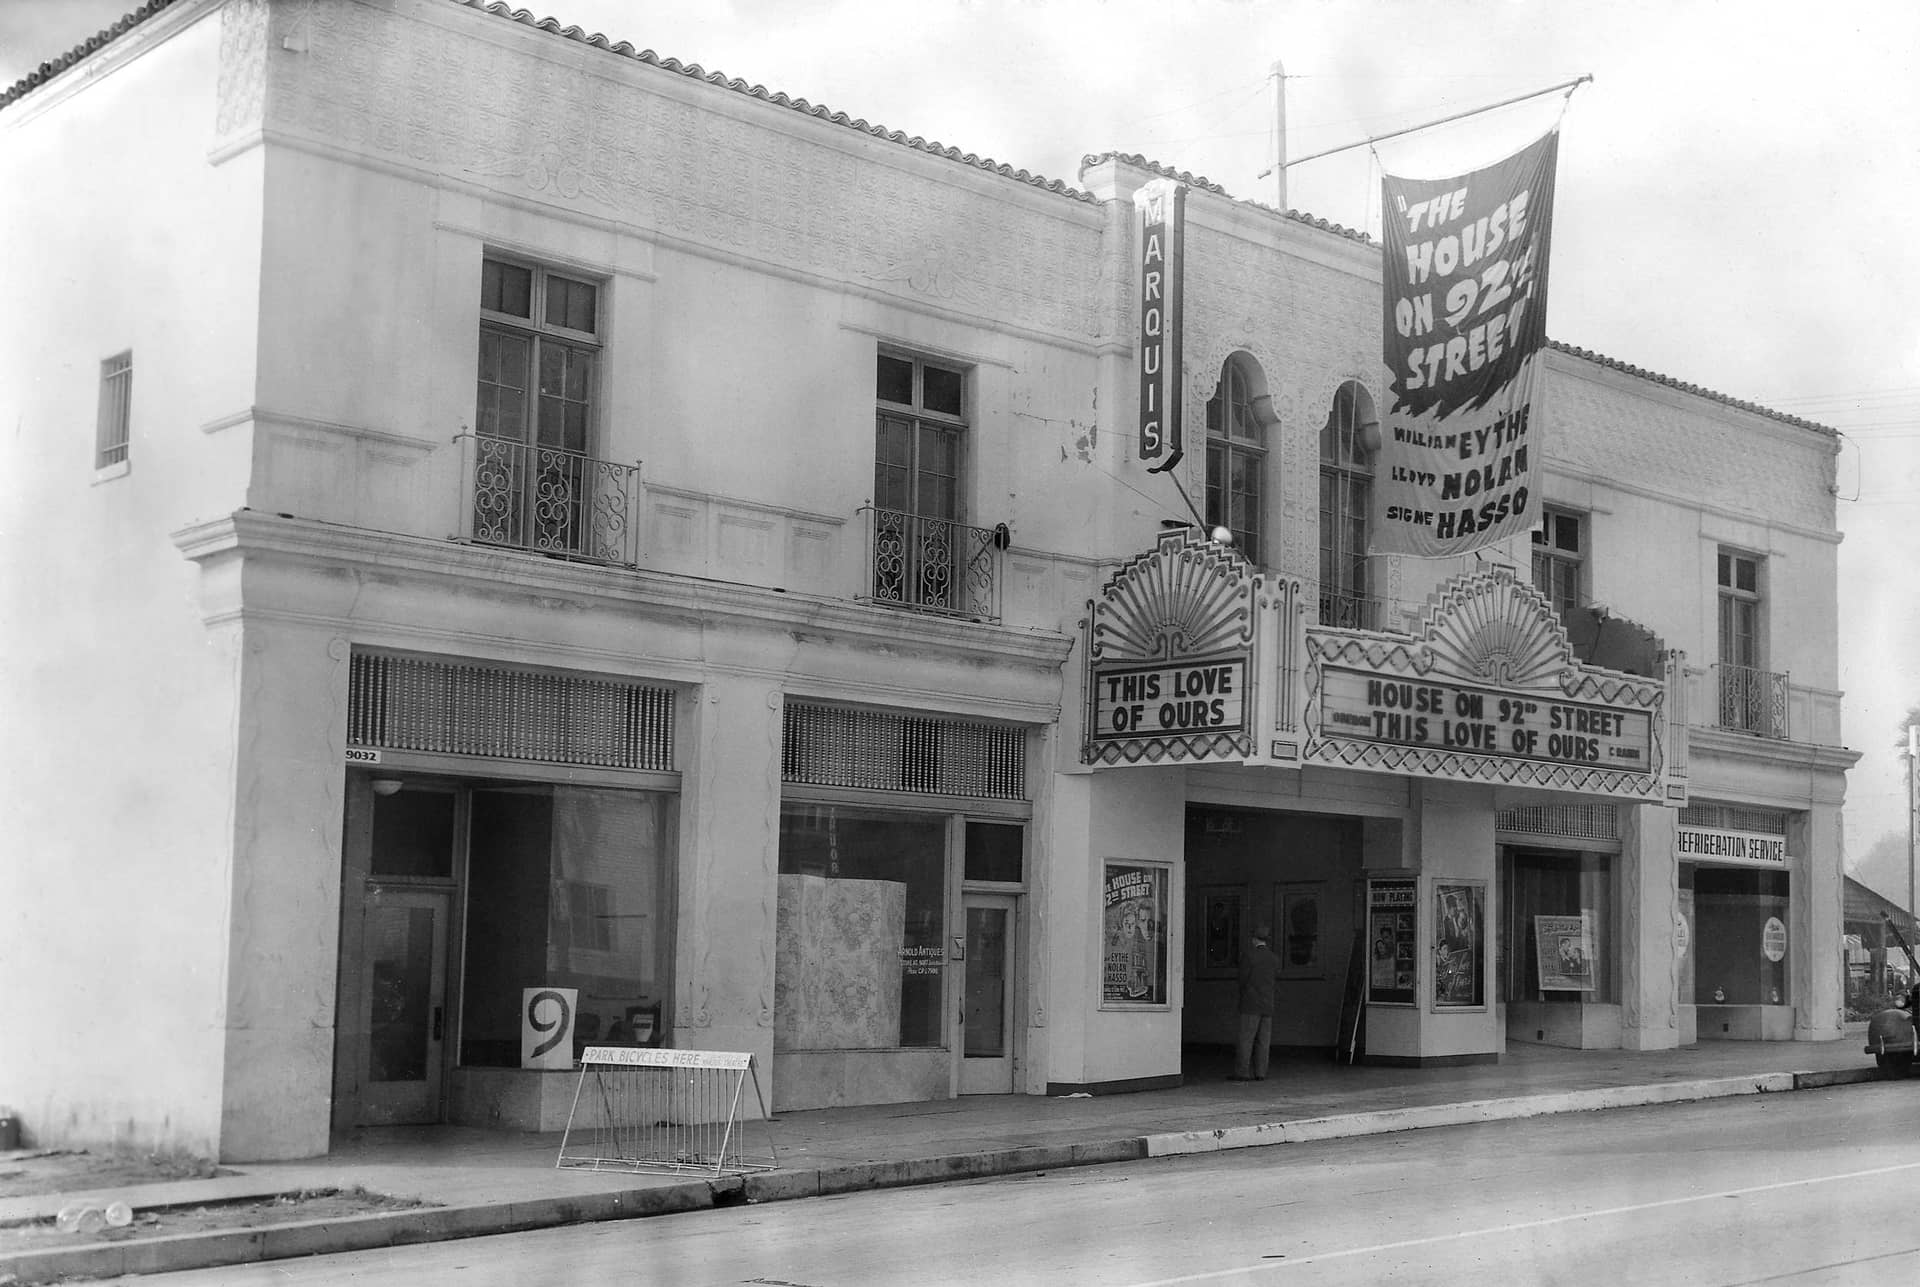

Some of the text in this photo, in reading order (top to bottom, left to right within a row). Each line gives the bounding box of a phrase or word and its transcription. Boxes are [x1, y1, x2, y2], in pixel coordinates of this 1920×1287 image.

[1406, 190, 1529, 286] HOUSE
[1144, 197, 1162, 451] MARQUIS
[1396, 293, 1433, 338] ON
[1460, 403, 1530, 460] EYTHE
[1392, 444, 1528, 500] LLOYD NOLAN
[1387, 487, 1529, 539] SIGNE HASSO
[1107, 667, 1233, 702] THIS LOVE
[1112, 699, 1225, 731] OF OURS
[1368, 680, 1443, 714] HOUSE
[1455, 693, 1483, 719] ON
[1550, 706, 1624, 737] STREET
[345, 750, 377, 761] 9032
[1373, 711, 1428, 741] THIS
[1444, 720, 1496, 749] LOVE
[1512, 729, 1538, 754] OF
[1548, 734, 1599, 761] OURS
[1749, 838, 1783, 861] SERVICE
[1112, 871, 1142, 890] HOUSE
[1121, 883, 1150, 900] STREET
[528, 990, 570, 1059] 9
[590, 1049, 614, 1062] PARK
[619, 1050, 669, 1064] BICYCLES
[673, 1053, 700, 1065] HERE
